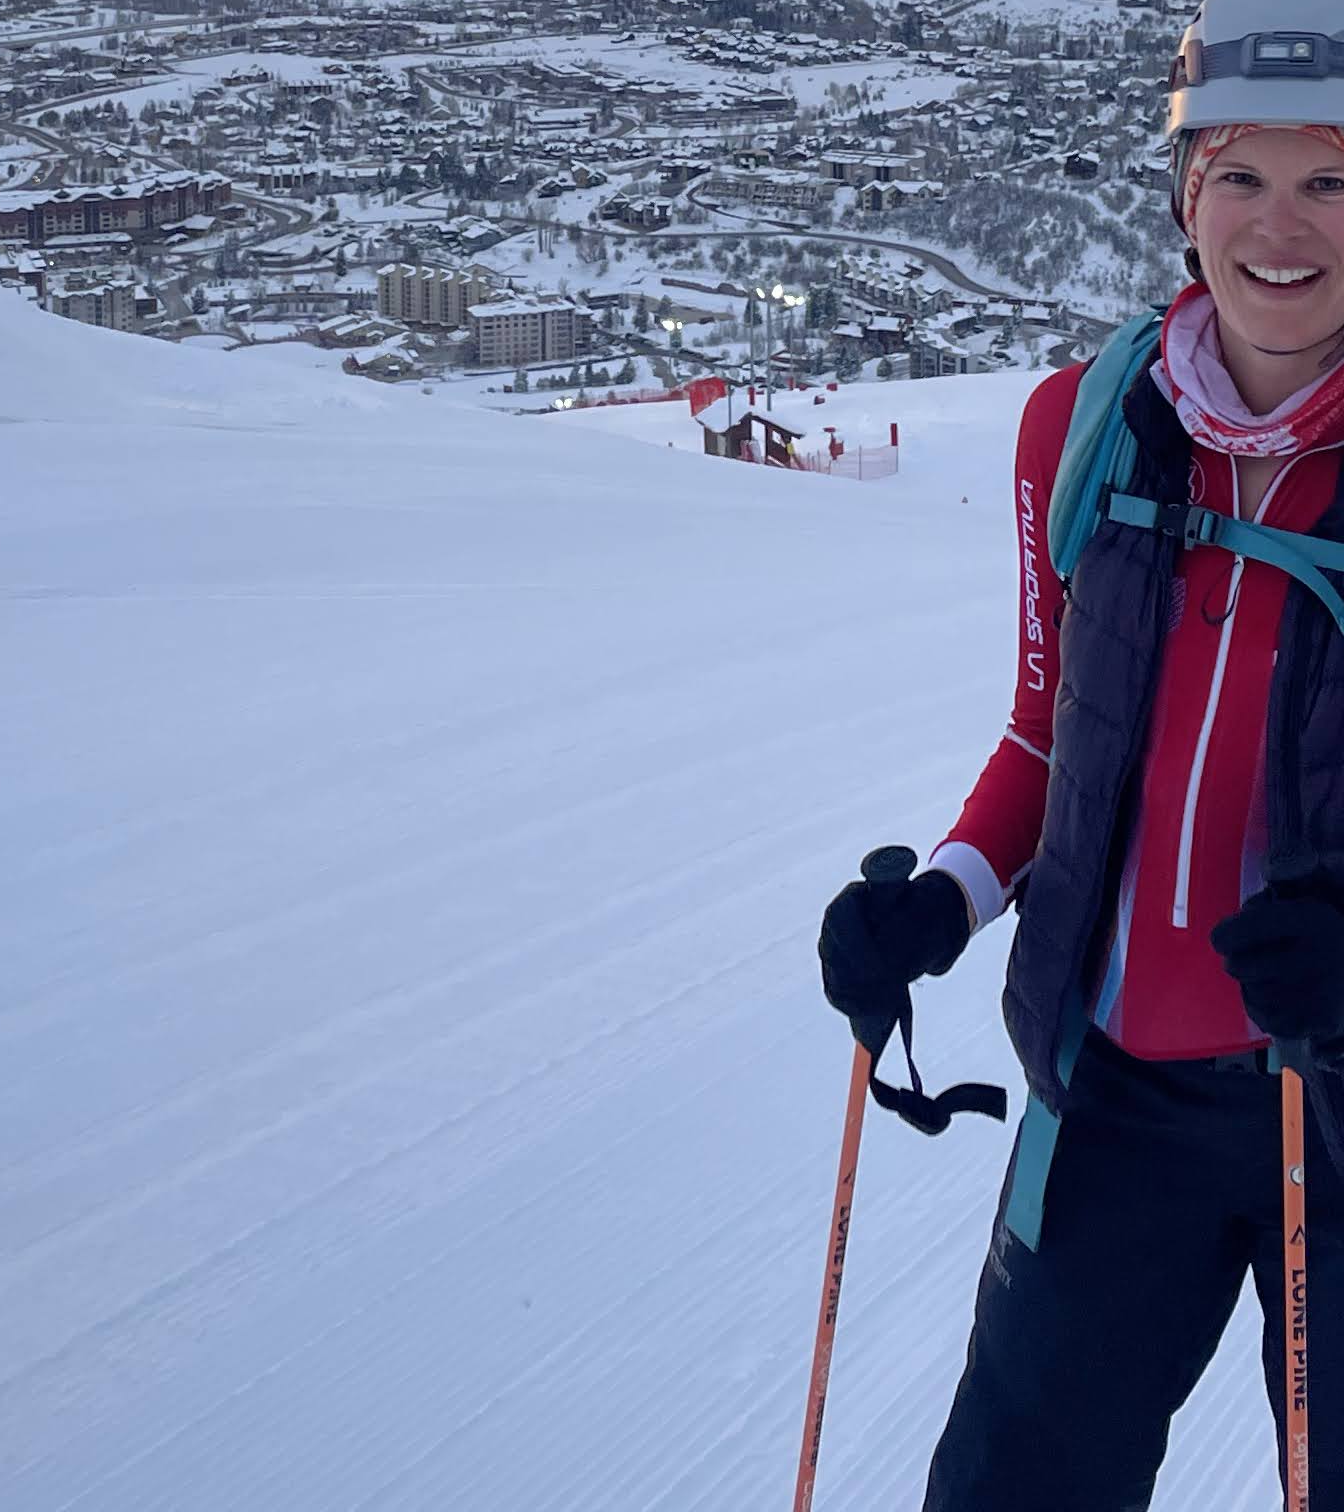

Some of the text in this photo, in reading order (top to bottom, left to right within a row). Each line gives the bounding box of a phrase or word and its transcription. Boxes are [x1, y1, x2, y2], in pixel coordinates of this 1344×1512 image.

[1021, 479, 1045, 692] LA SPORTIVA
[1292, 1269, 1307, 1412] LONE PINE
